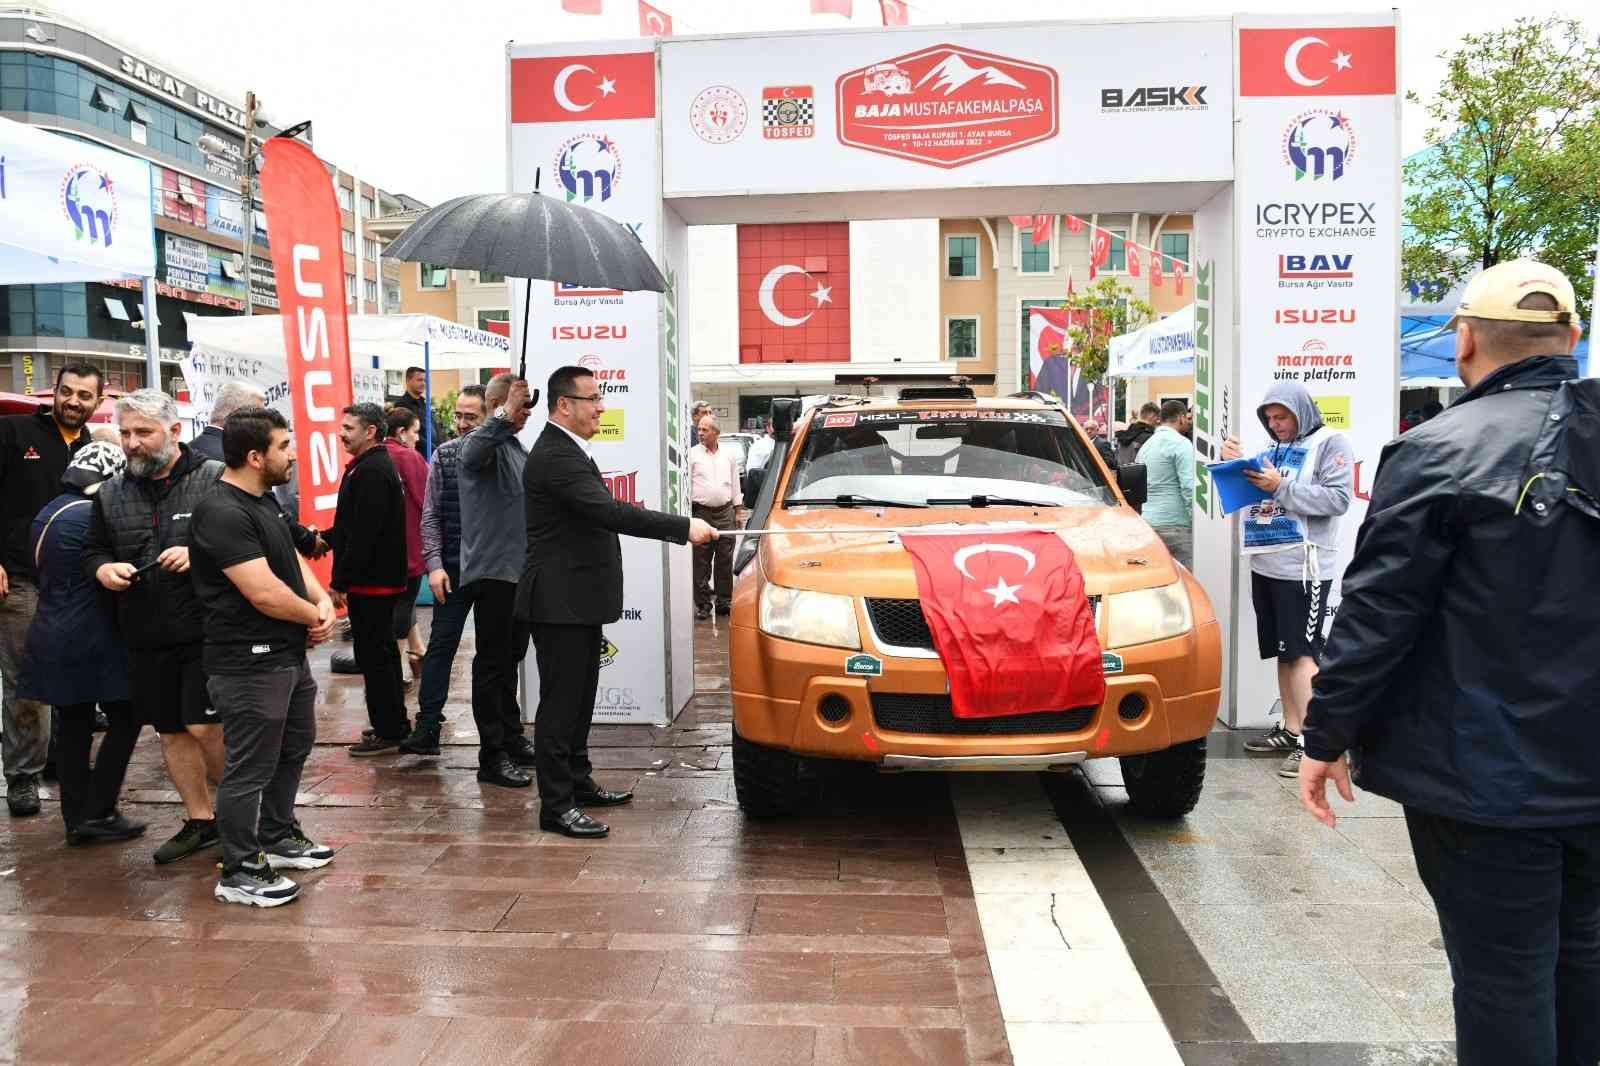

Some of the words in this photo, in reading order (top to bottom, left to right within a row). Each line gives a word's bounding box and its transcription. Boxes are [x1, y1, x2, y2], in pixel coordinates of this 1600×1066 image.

[121, 55, 187, 98] SARAY
[855, 103, 901, 118] BAJA
[903, 98, 1044, 116] MUSTAFAKEMALPAŞA
[766, 127, 812, 137] TOSFED
[1256, 202, 1376, 225] ICRYPEX
[1256, 228, 1305, 238] CRYPTO
[1309, 227, 1376, 238] EXCHANGE
[1286, 254, 1353, 270] BAV
[1278, 280, 1305, 288] Bursa
[554, 298, 578, 306] Bursa
[1275, 309, 1356, 324] ISUZU
[552, 325, 627, 340] ISUZU
[1277, 354, 1353, 367] marmara
[1303, 367, 1357, 382] platform
